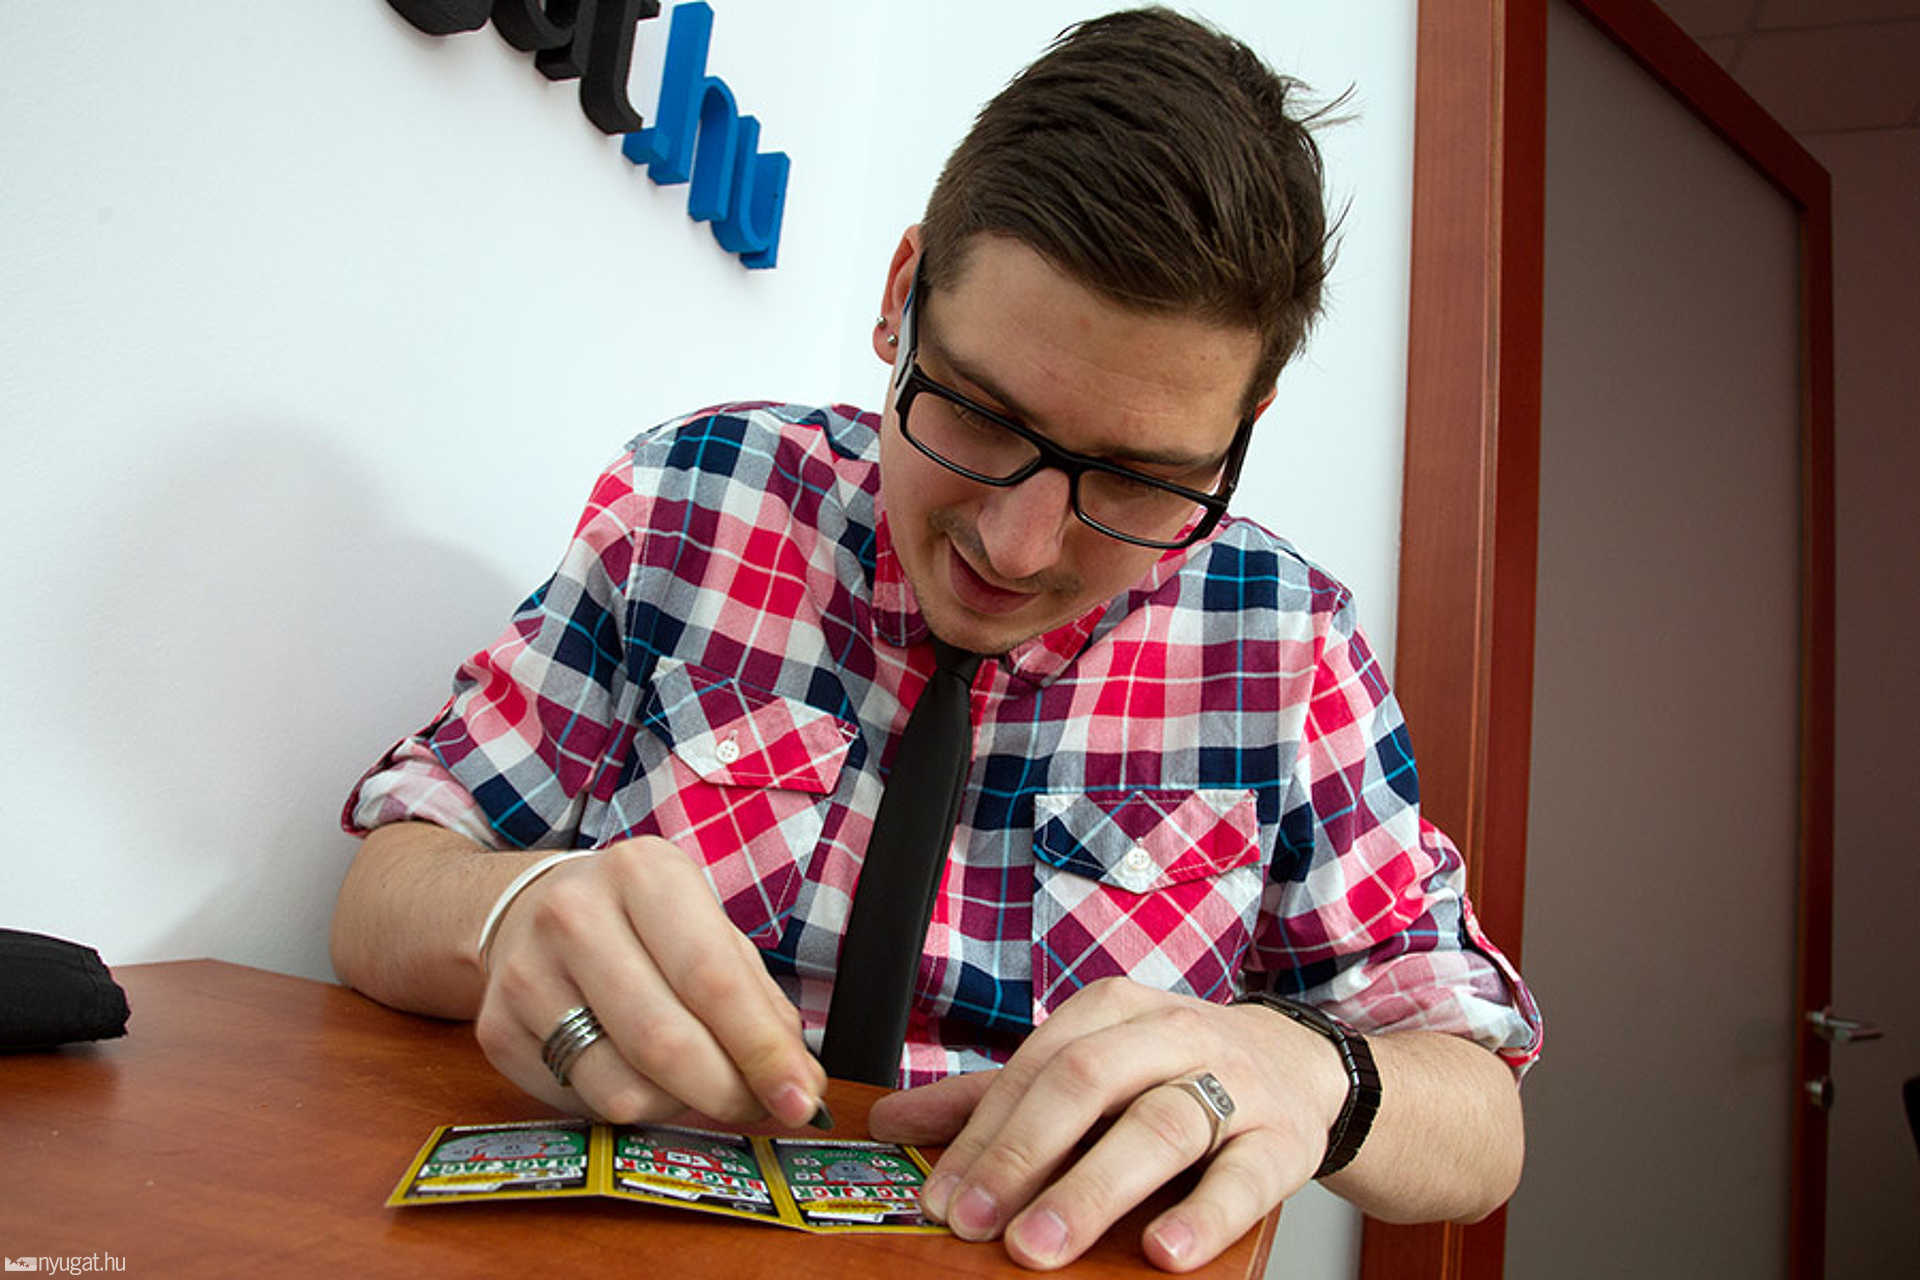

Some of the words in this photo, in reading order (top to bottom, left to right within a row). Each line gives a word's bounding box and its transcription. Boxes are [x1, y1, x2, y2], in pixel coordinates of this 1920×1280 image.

[427, 1161, 493, 1177] JACK
[502, 1156, 582, 1171] BLACK
[620, 1158, 682, 1178] JACK
[687, 1170, 764, 1191] BLACK
[797, 1186, 857, 1199] JACK
[862, 1186, 921, 1199] LACK
